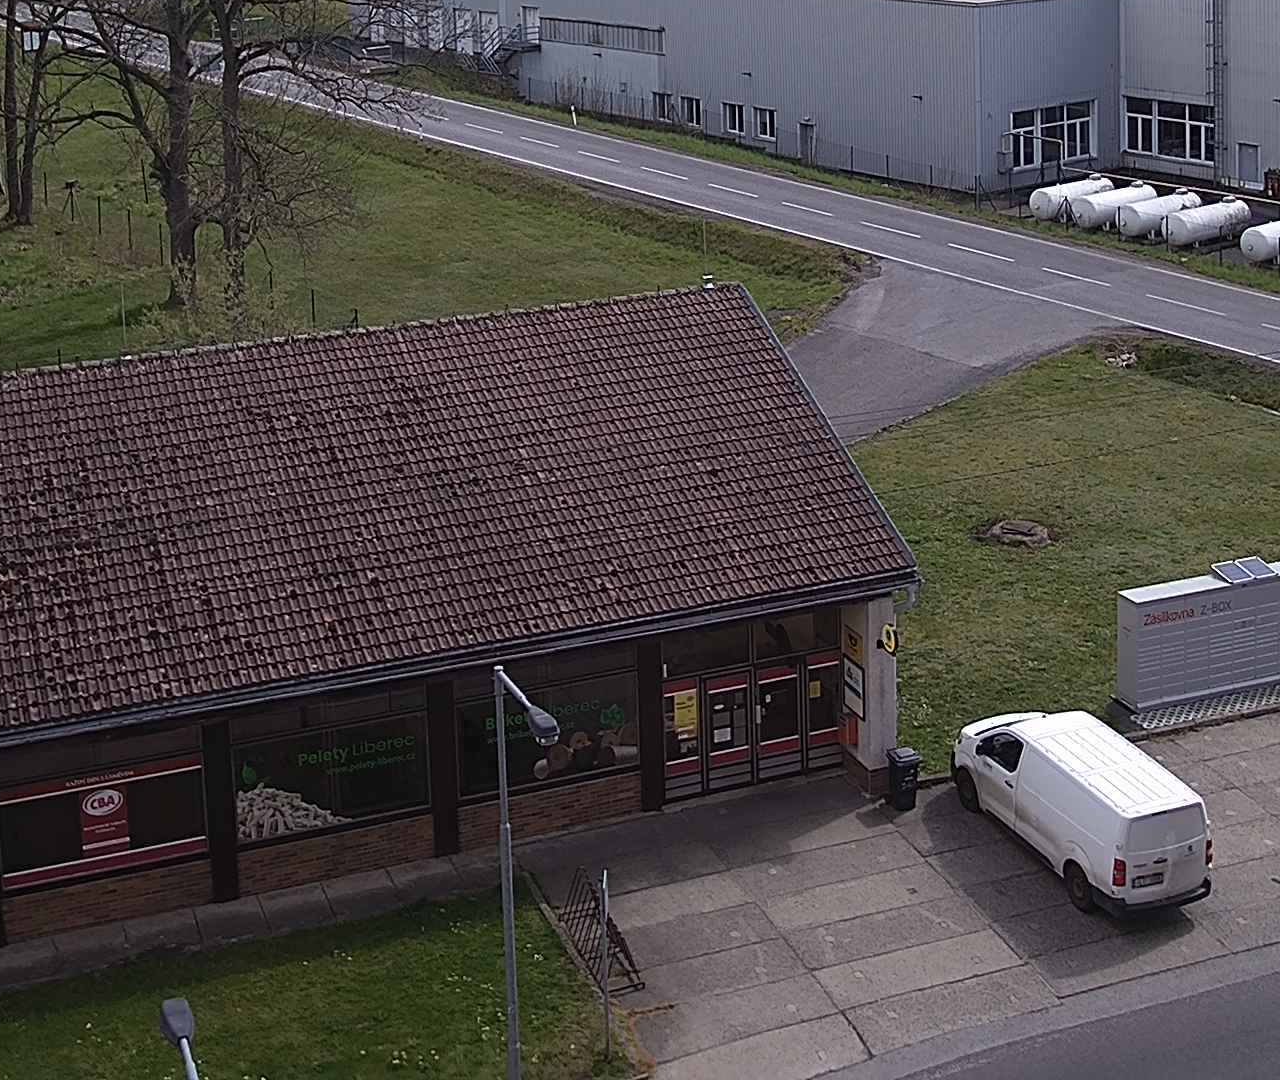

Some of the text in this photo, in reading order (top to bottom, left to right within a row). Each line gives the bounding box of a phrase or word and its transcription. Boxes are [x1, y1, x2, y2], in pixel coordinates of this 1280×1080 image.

[297, 735, 416, 766] Pelety Liberec
[90, 794, 116, 810] CBA
